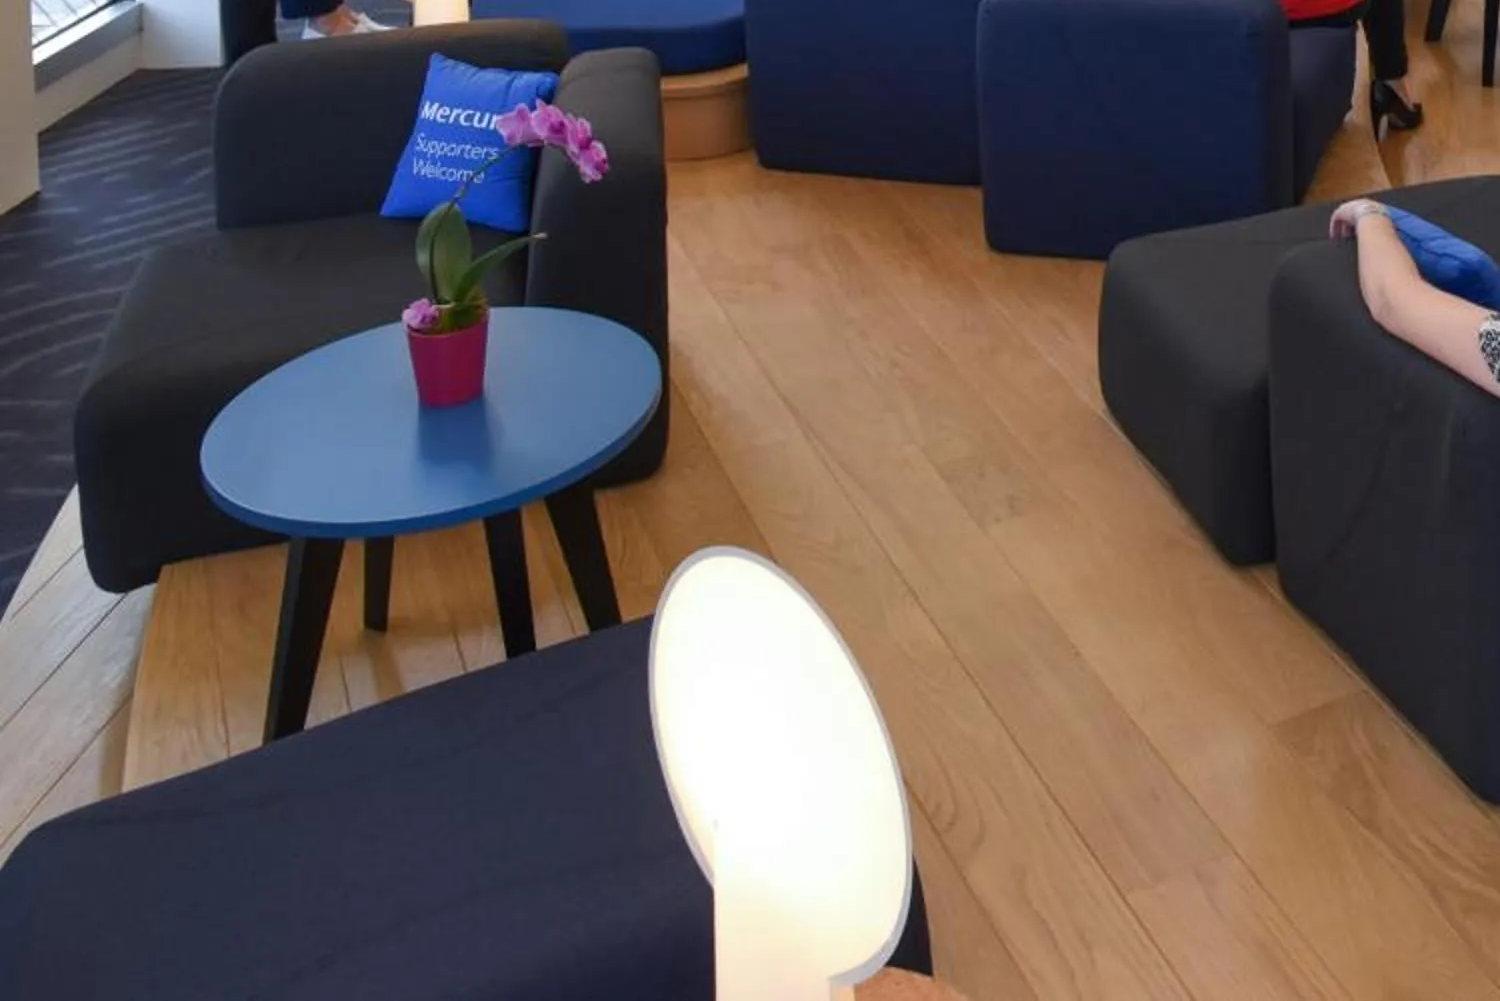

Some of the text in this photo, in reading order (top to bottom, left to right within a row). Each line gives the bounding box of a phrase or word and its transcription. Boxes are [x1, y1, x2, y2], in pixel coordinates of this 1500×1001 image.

[420, 101, 499, 130] Mercur
[416, 133, 500, 160] Supporters
[412, 158, 485, 184] Welcome
